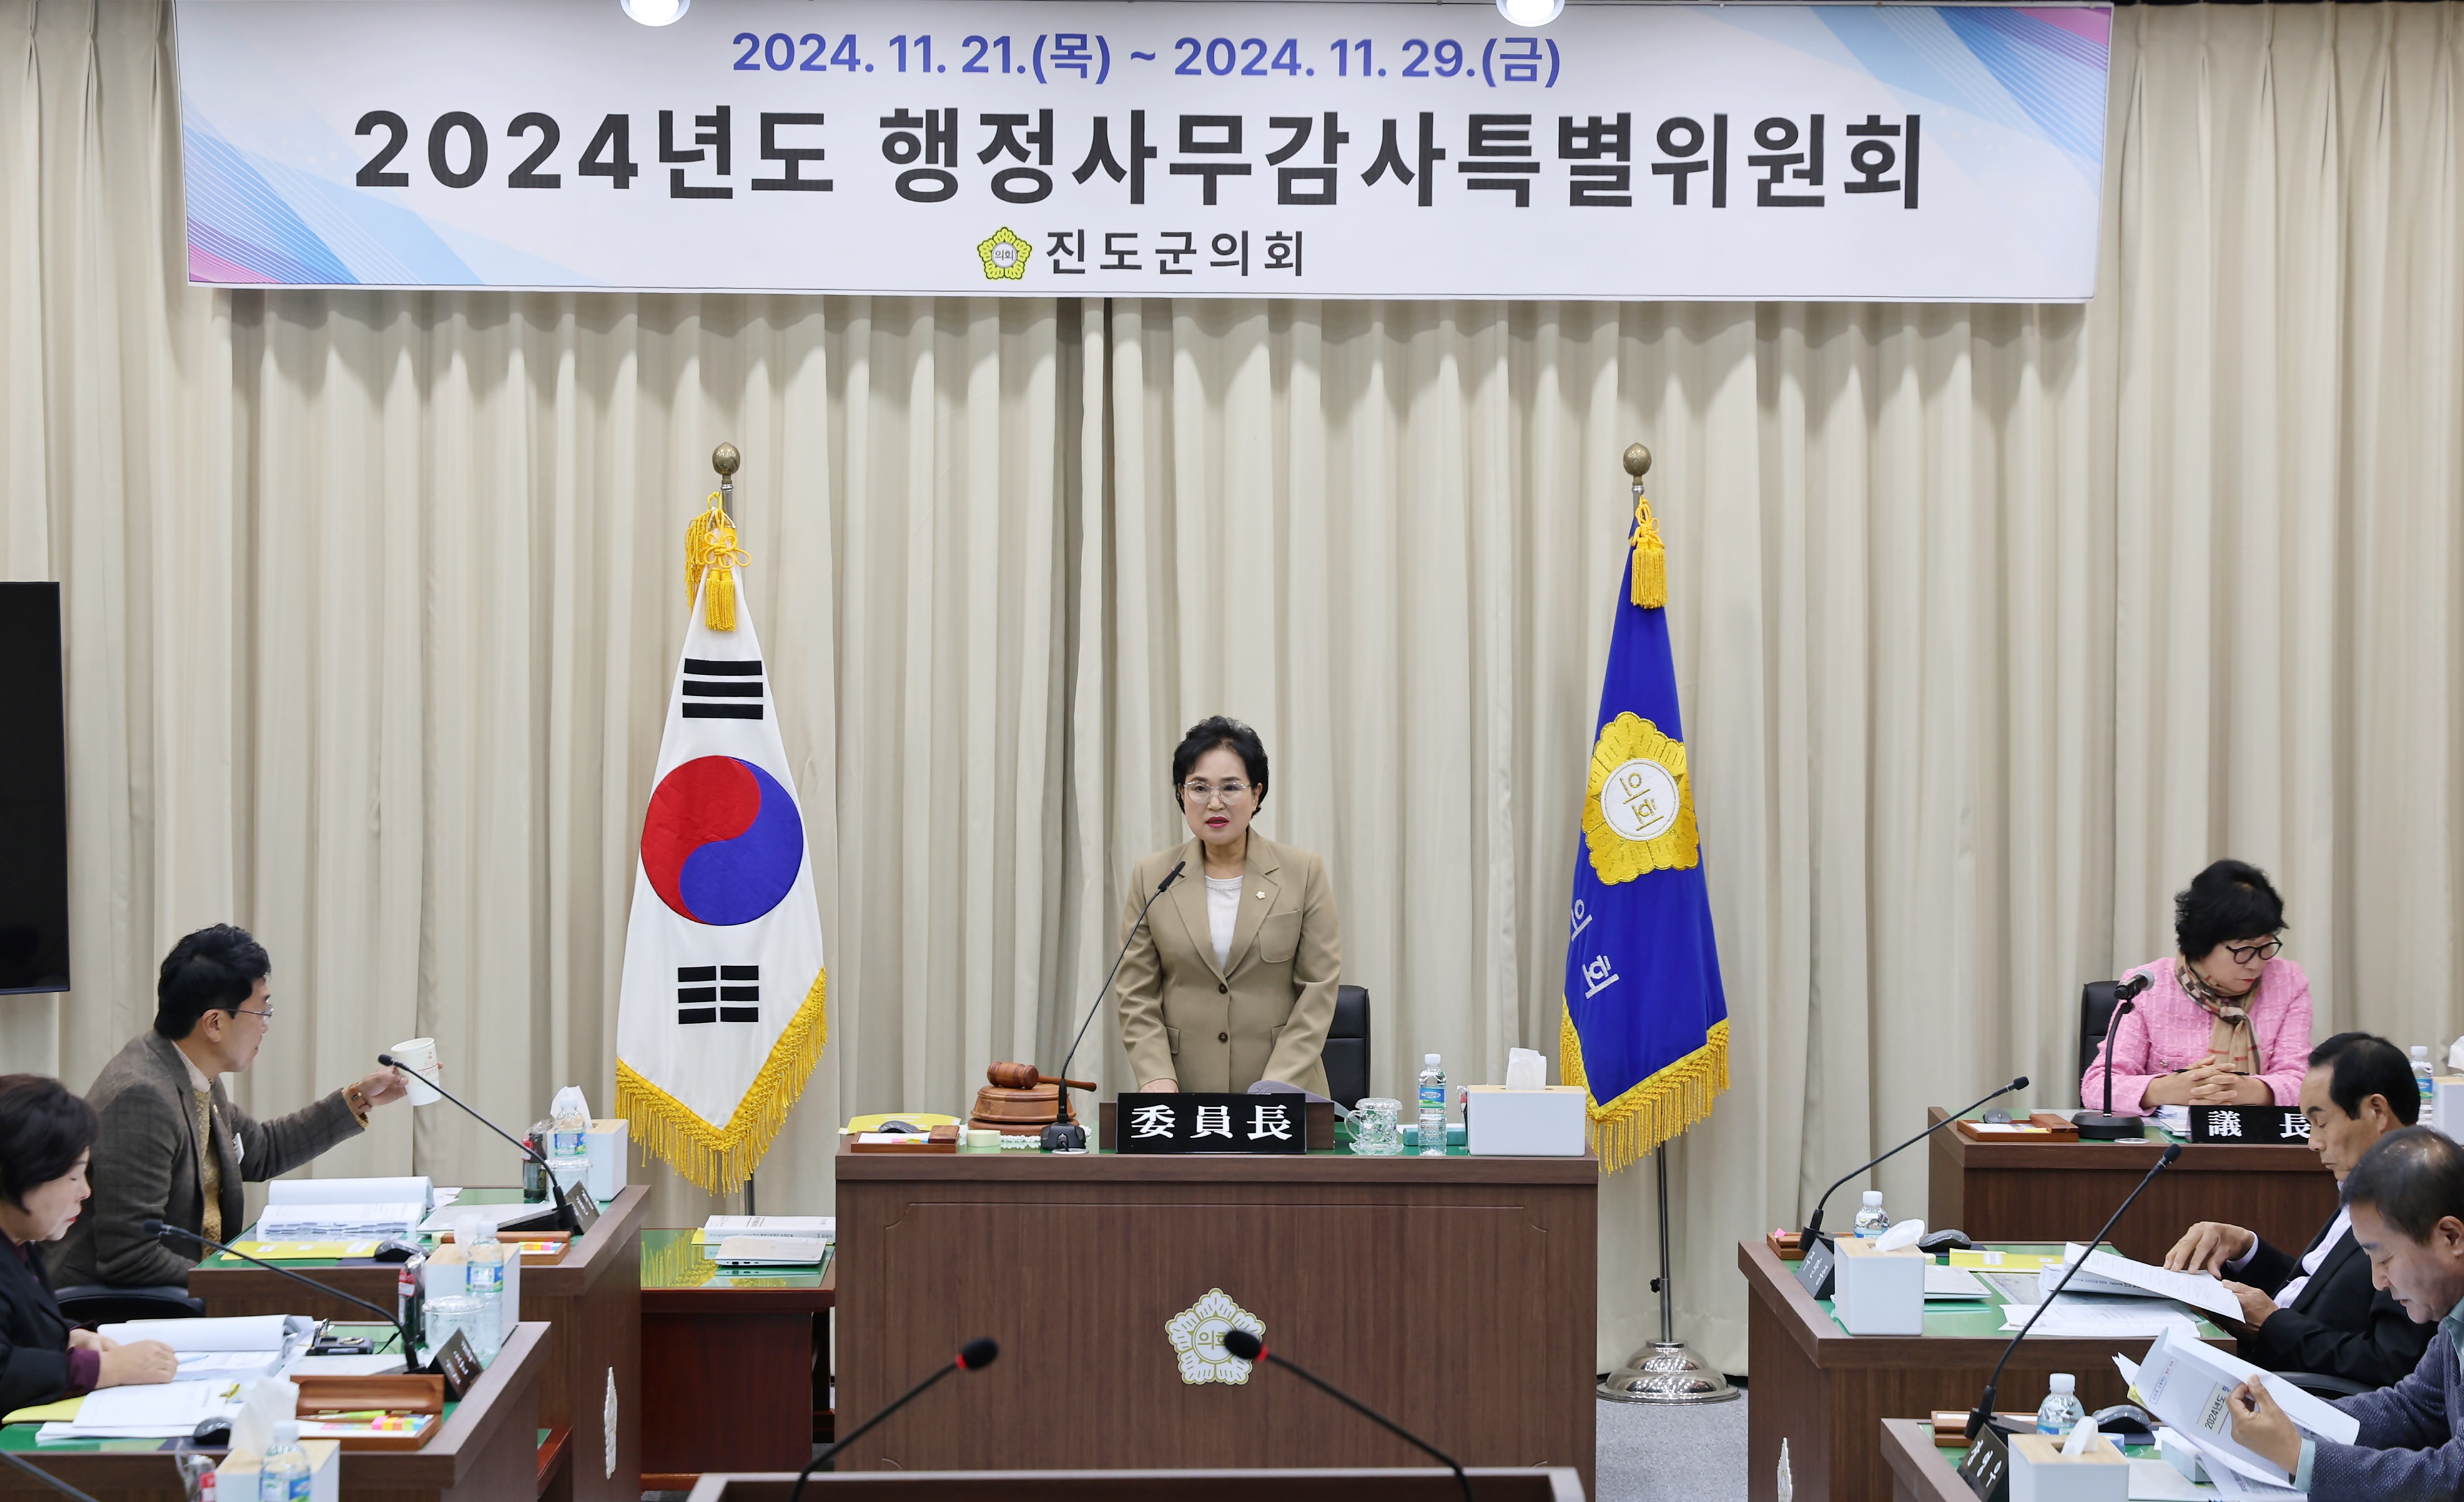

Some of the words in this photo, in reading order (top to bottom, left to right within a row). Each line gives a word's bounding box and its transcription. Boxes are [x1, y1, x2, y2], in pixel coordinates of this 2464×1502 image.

[734, 32, 874, 73] 2024.
[890, 34, 946, 73] 11.
[963, 33, 1110, 85] 21.(목)
[1175, 37, 1315, 77] 2024.
[1331, 39, 1387, 77] 11.
[1403, 37, 1560, 88] 29.(금)
[355, 105, 833, 200] 2024년도
[879, 107, 1921, 210] 행정사무감사특별위원회
[995, 249, 1013, 260] 의회
[1047, 229, 1303, 277] 진도군의회
[1130, 1104, 1293, 1141] 委員長
[2207, 1109, 2312, 1139] 議長
[2204, 1394, 2227, 1430] 2024년도
[1966, 1439, 2003, 1488] 장영우
